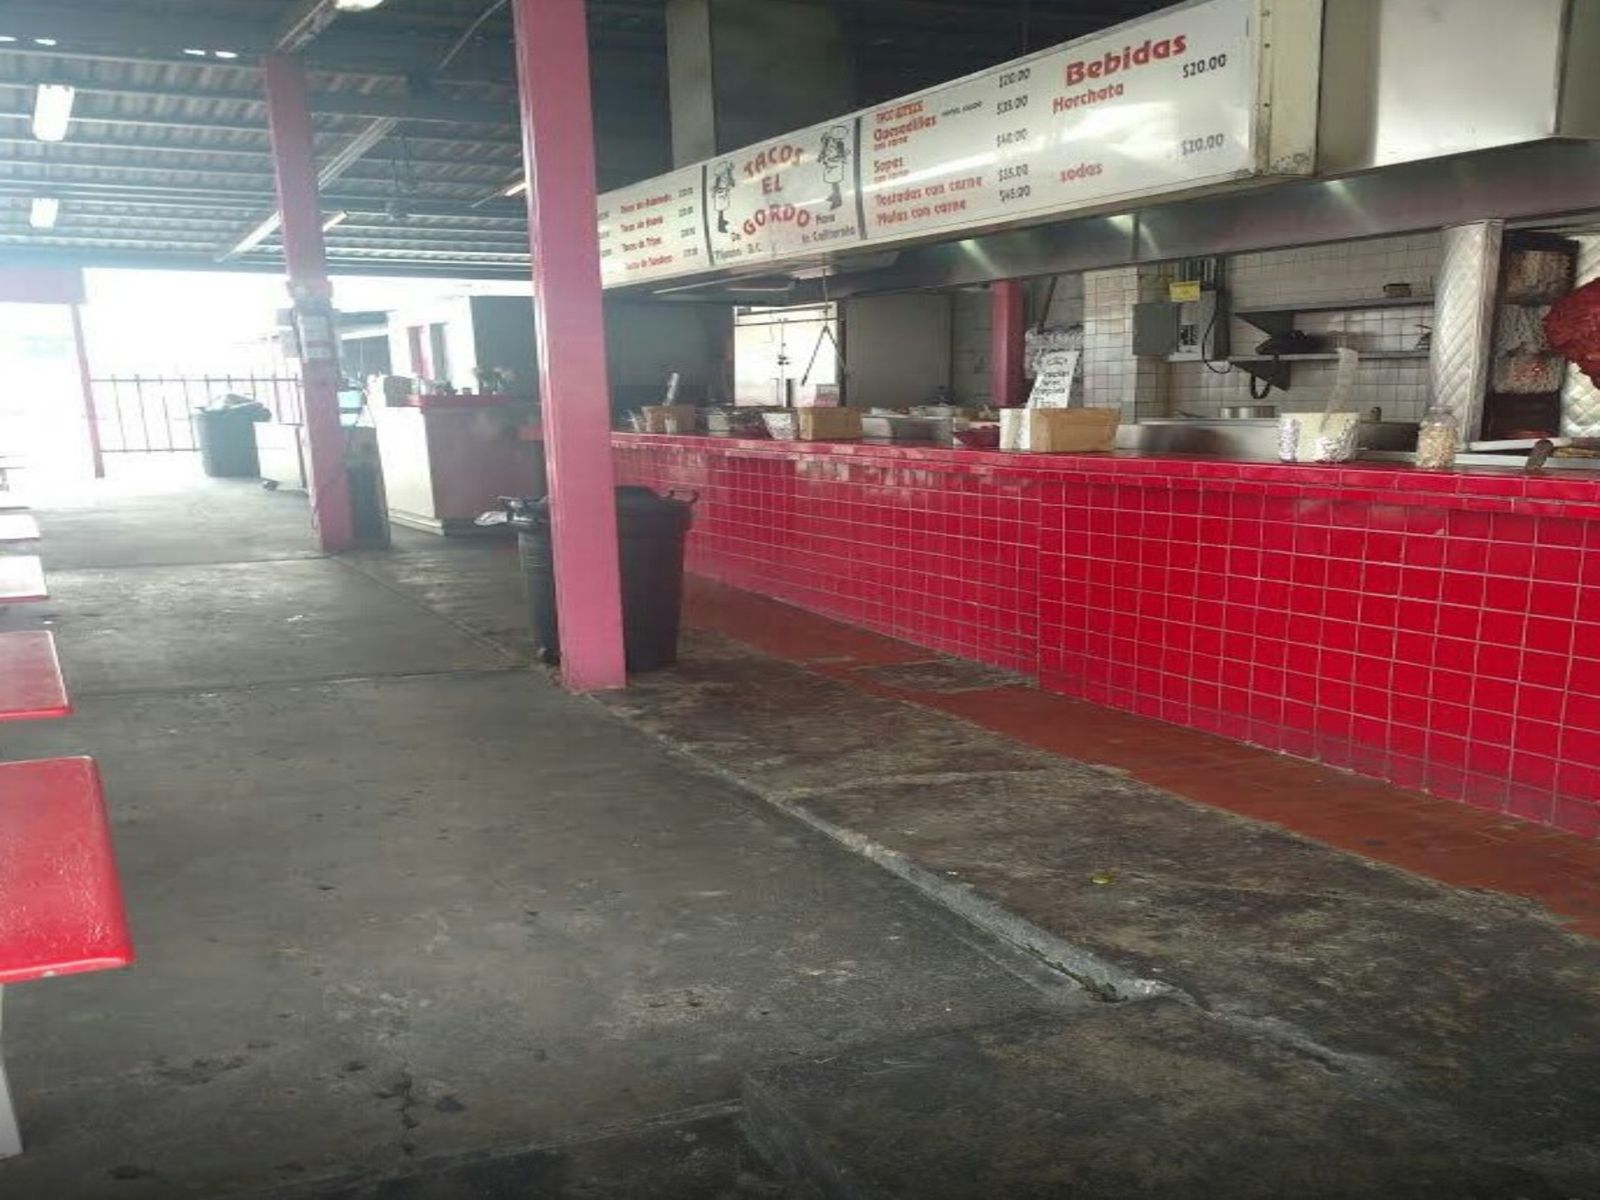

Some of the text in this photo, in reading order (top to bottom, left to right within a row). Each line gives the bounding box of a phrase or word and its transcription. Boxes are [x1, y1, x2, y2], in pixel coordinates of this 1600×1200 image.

[1066, 34, 1187, 87] Bebidas
[1052, 83, 1124, 115] Horchata
[744, 145, 803, 177] TACOS
[1060, 163, 1103, 184] sodas
[761, 173, 783, 195] EL
[874, 188, 923, 207] Tostadas
[924, 184, 945, 197] con
[743, 204, 809, 234] GORDO
[910, 206, 931, 219] con
